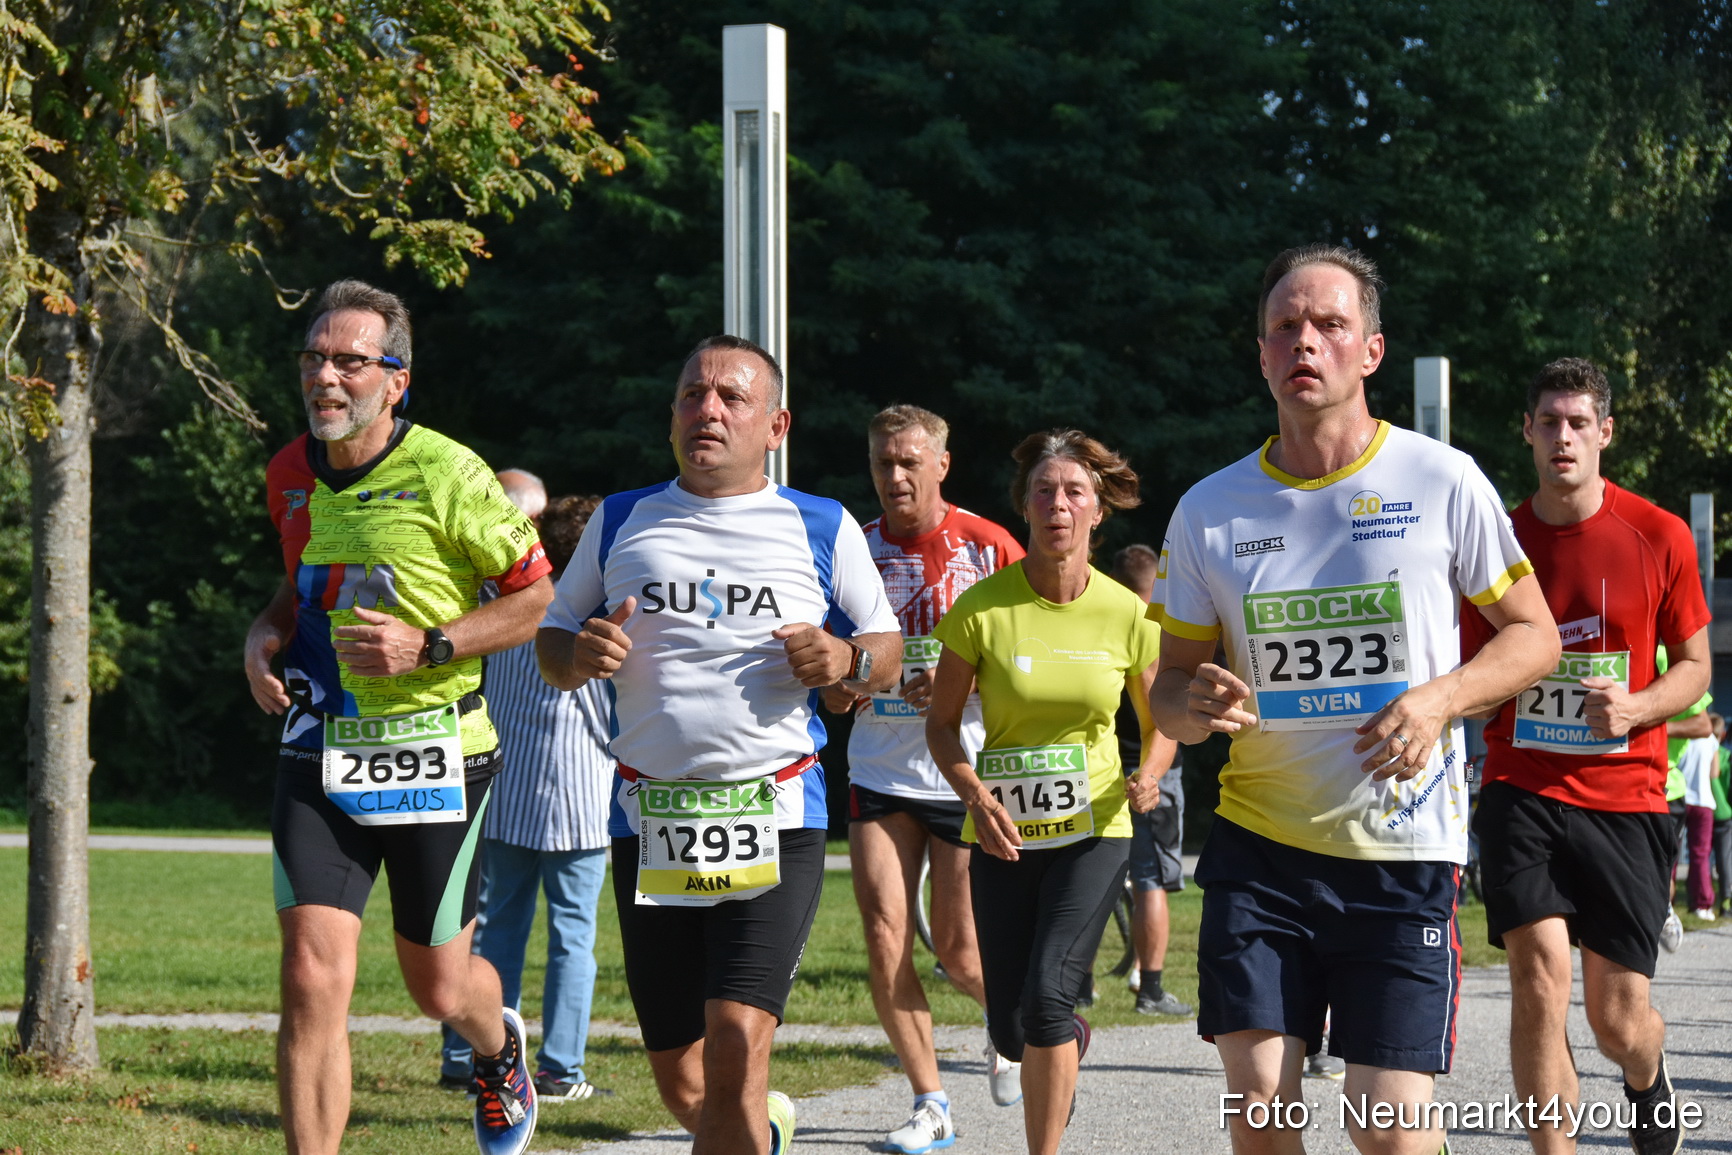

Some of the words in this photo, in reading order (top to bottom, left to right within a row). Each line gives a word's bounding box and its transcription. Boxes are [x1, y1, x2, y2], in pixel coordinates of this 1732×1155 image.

[1352, 496, 1380, 517] 20
[1384, 502, 1410, 512] JAHRE
[1352, 514, 1420, 529] Neumarkter
[1352, 527, 1407, 542] Stadtlauf
[1235, 537, 1285, 554] BOCK
[641, 572, 782, 625] SUSPA
[1254, 589, 1388, 626] BOCK
[1264, 633, 1389, 682] 2323
[1555, 658, 1617, 677] OCK
[1298, 692, 1361, 714] SVEN
[1528, 685, 1591, 720] 217
[336, 711, 446, 741] BOCK
[1534, 725, 1606, 743] THOMA
[341, 746, 447, 785] 2693
[984, 750, 1073, 776] BOCK
[357, 788, 445, 812] CLAUS
[649, 786, 760, 812] BOCK
[990, 780, 1076, 814] 1143
[1412, 769, 1446, 809] Septembe
[1019, 819, 1075, 838] IGITTE
[657, 824, 760, 864] 1293
[684, 874, 732, 892] AKIN
